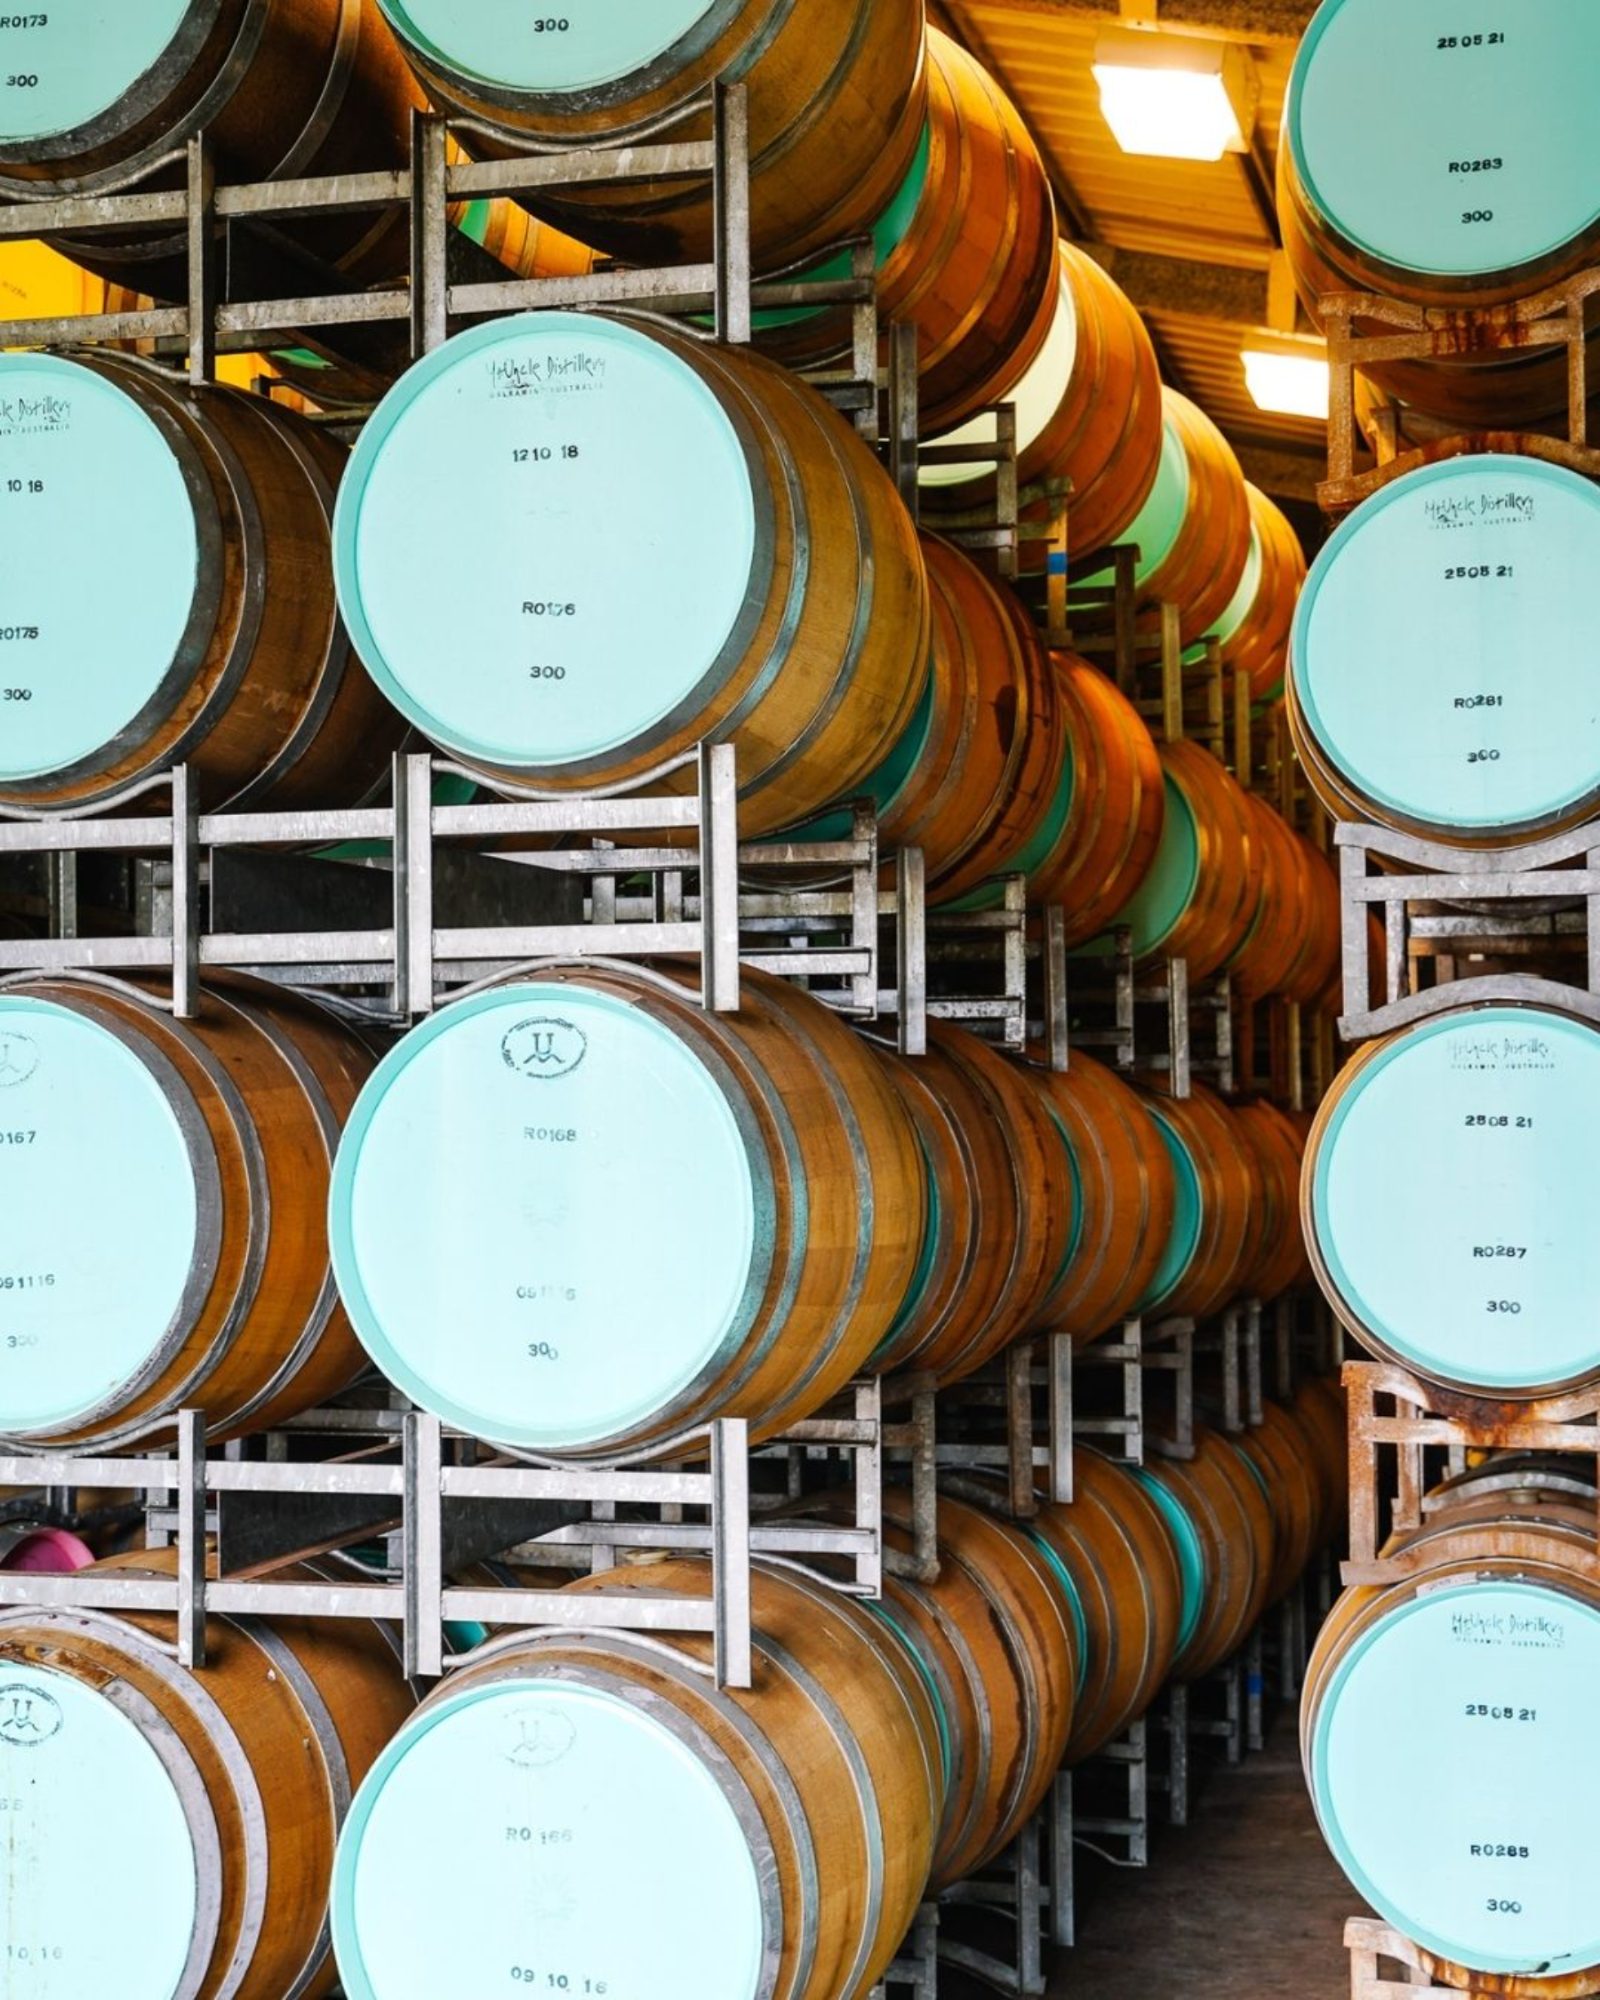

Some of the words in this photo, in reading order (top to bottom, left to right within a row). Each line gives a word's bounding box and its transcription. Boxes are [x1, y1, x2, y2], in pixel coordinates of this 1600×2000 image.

[0, 14, 47, 28] R0173
[534, 19, 569, 32] 300
[6, 75, 38, 87] 300
[1449, 158, 1502, 173] R0283
[1462, 210, 1493, 224] 300
[562, 445, 578, 458] 18
[28, 480, 43, 493] 18
[530, 666, 565, 680] 300
[4, 689, 32, 701] 300
[1454, 695, 1502, 709] R0281
[1467, 749, 1500, 763] 300
[1516, 1116, 1532, 1128] 21
[1473, 1245, 1527, 1259] R0287
[1486, 1300, 1521, 1314] 300
[528, 1342, 558, 1360] 300
[1519, 1709, 1536, 1721] 21
[1487, 1899, 1522, 1914] 300
[511, 1966, 534, 1983] 09
